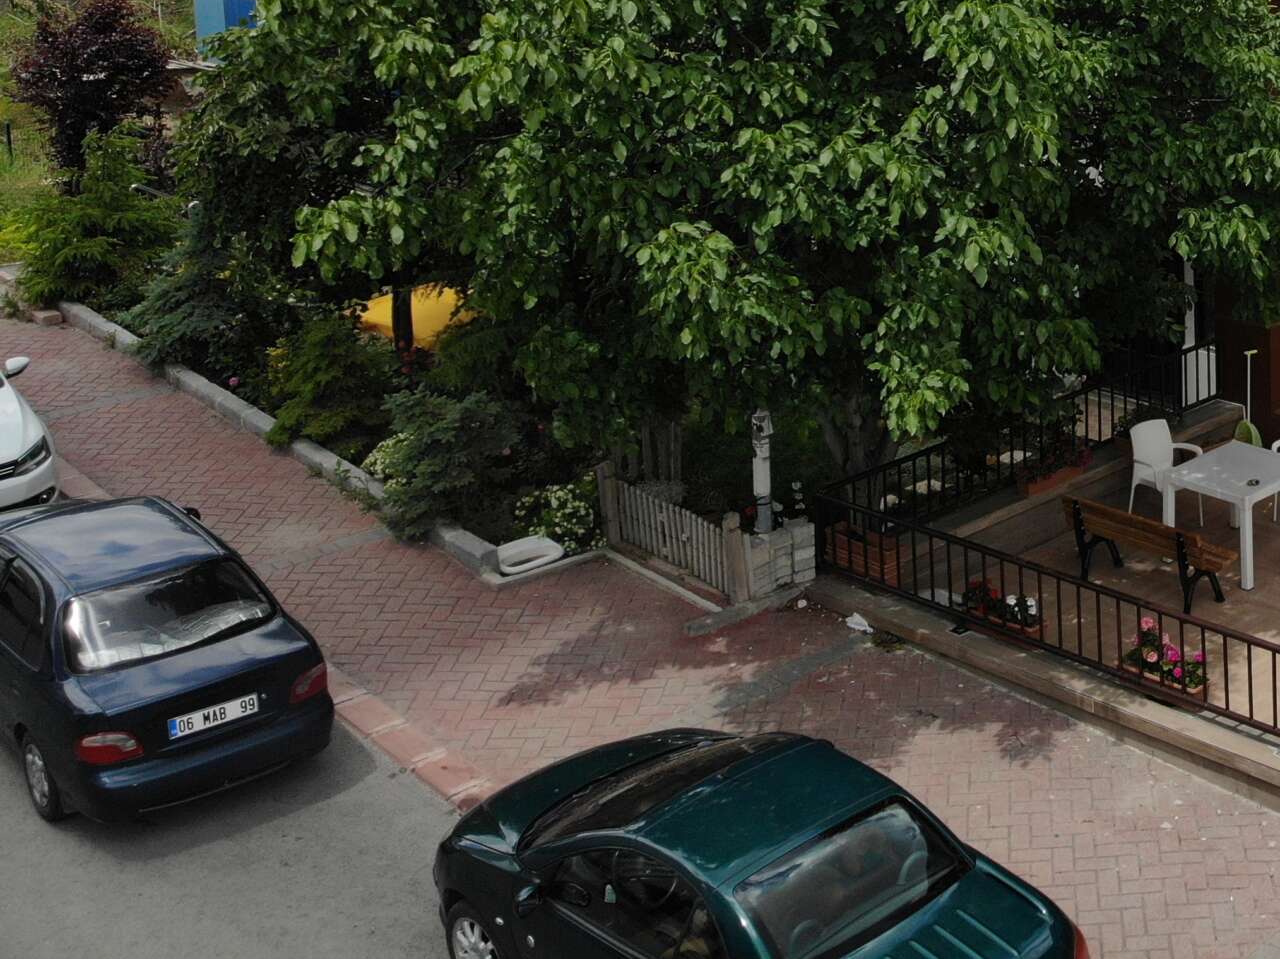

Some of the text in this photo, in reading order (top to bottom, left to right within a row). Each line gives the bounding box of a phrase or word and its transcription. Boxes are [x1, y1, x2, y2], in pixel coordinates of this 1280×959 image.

[178, 697, 255, 733] 06 MAB 99
